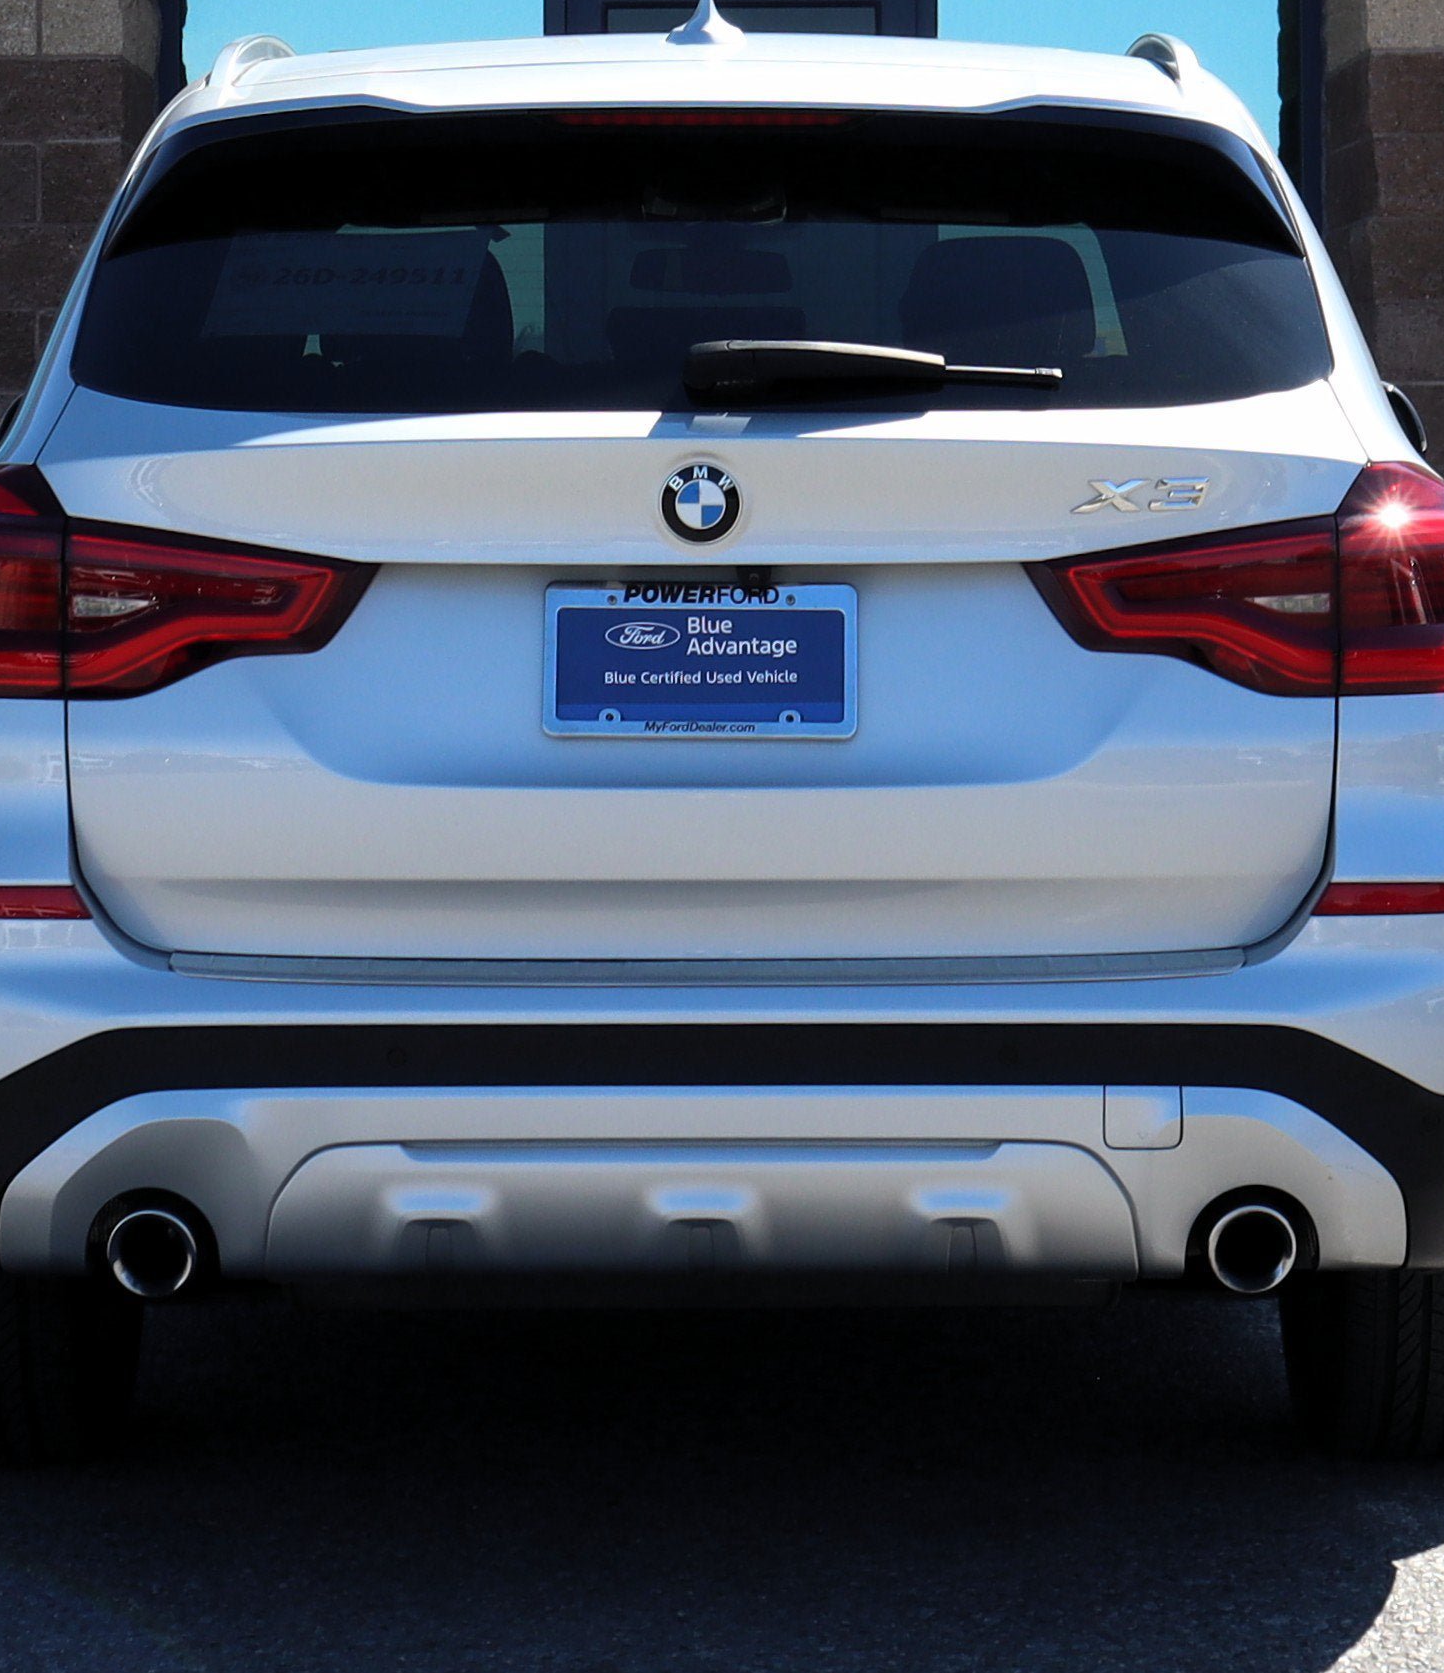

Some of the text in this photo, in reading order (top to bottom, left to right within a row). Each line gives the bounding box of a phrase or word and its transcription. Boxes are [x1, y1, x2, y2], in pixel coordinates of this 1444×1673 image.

[668, 465, 736, 492] BMW
[1070, 477, 1209, 514] X3
[619, 625, 666, 646] Ford
[687, 616, 733, 635] Blue
[686, 636, 798, 658] Advantage
[604, 669, 798, 685] Blue Certified Used Vehicle
[644, 721, 756, 734] MyFordDealer.com
